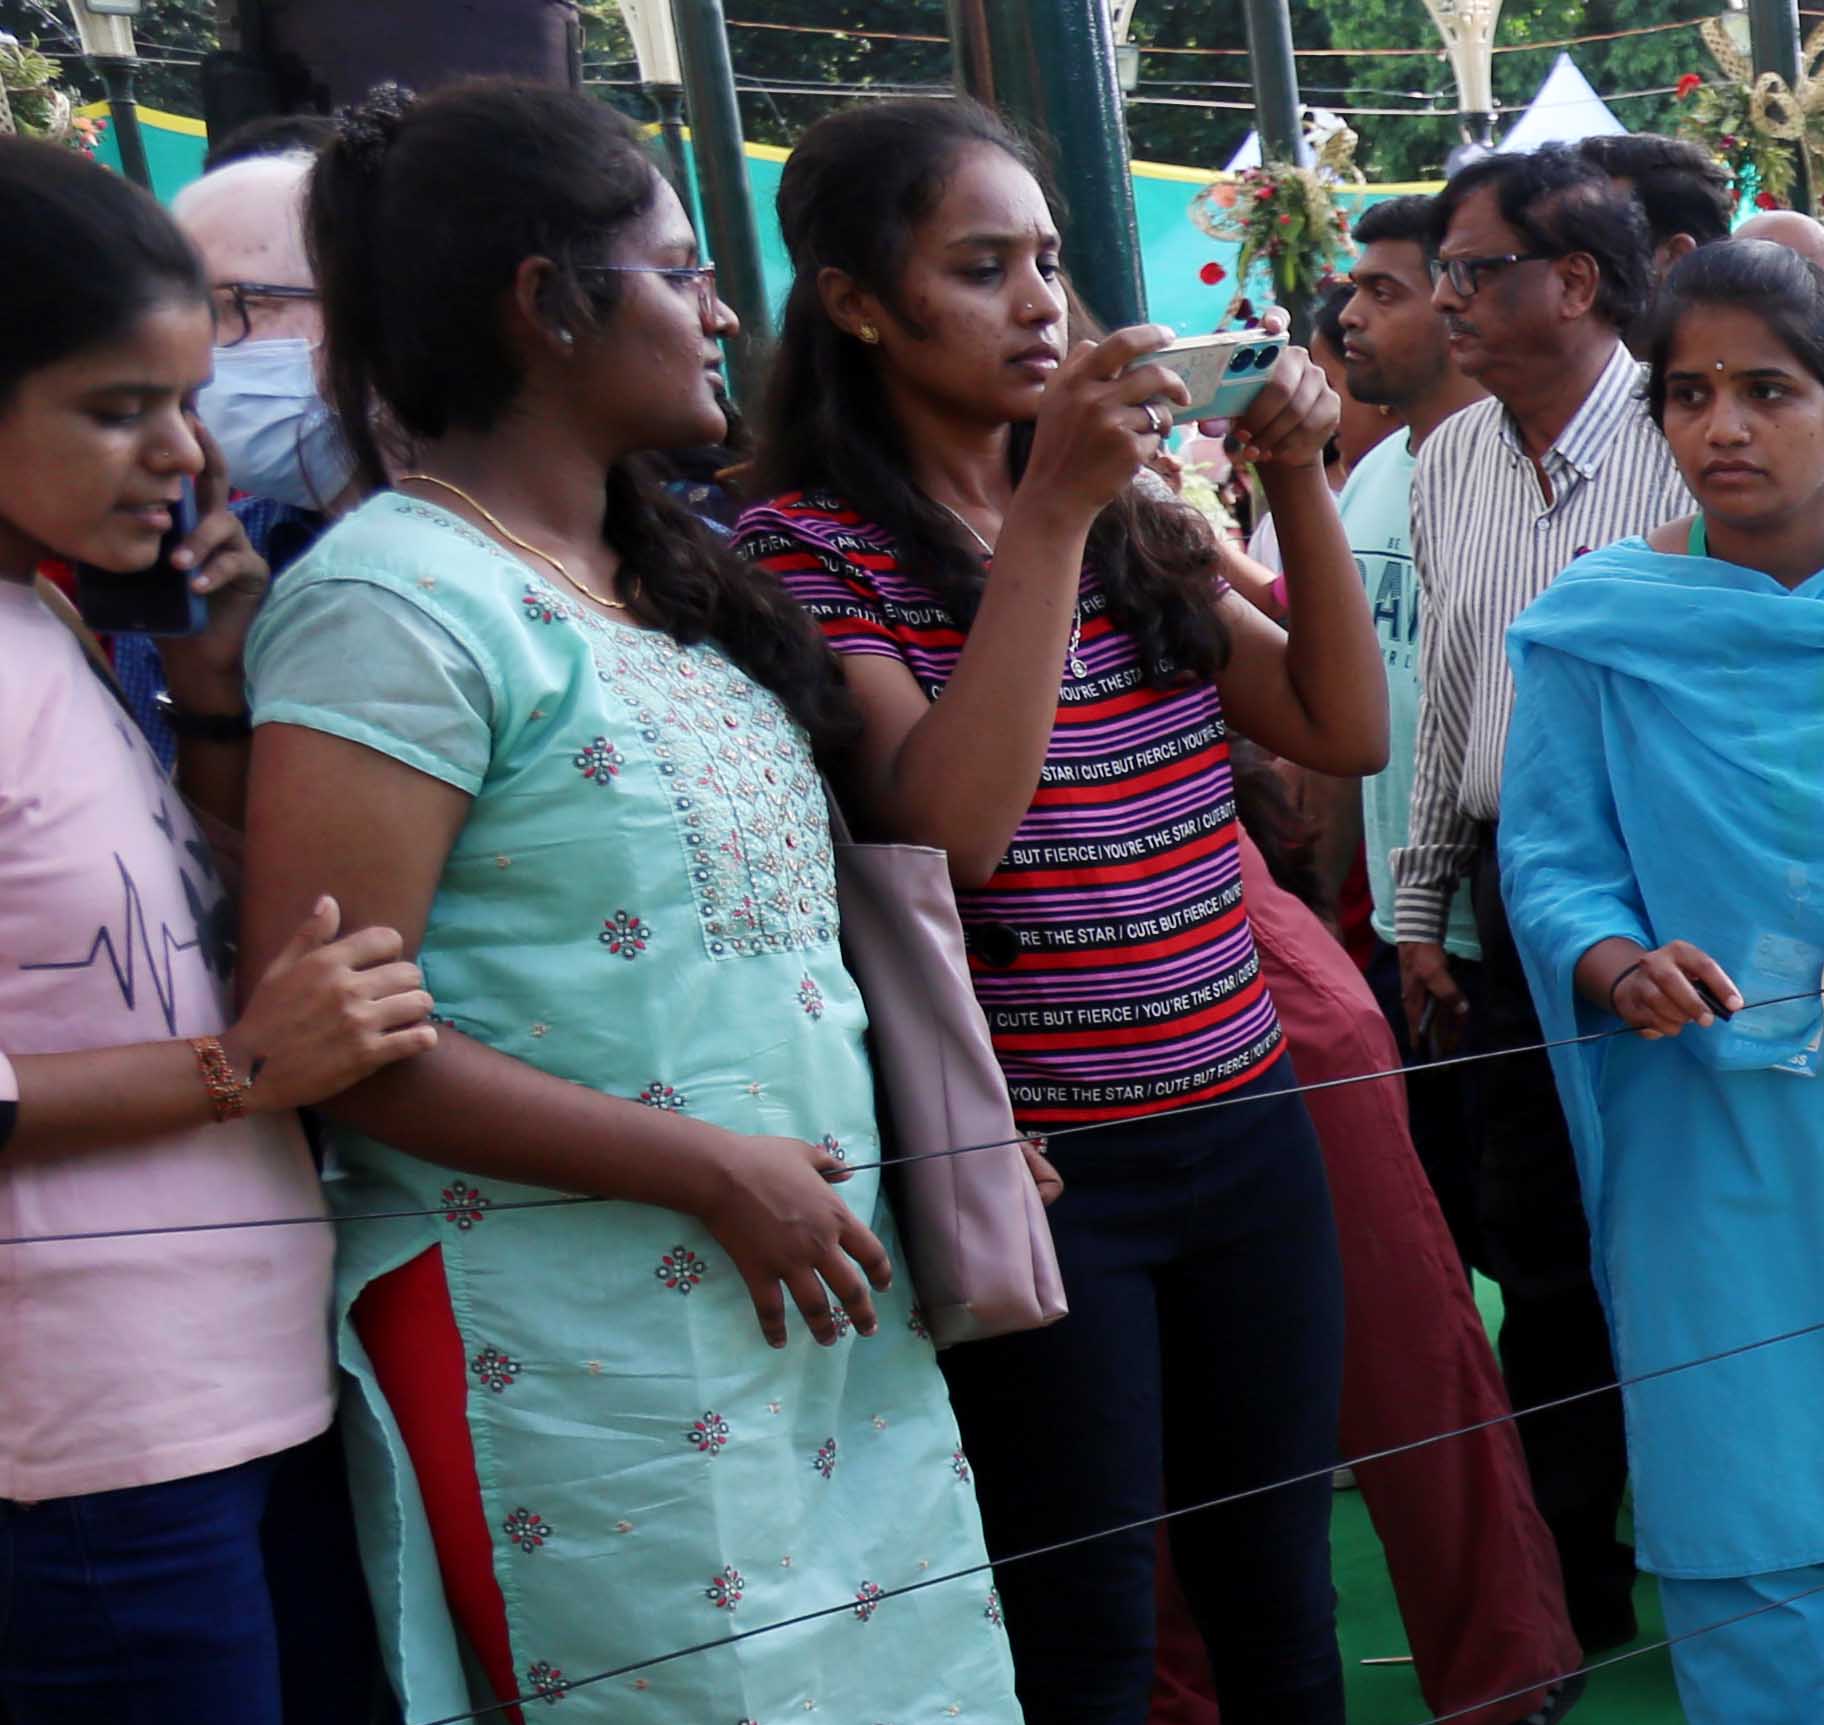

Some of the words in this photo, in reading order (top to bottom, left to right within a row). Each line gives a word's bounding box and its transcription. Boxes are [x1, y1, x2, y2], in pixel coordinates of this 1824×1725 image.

[1041, 764, 1073, 782] STAR
[1081, 762, 1112, 781] CUTE
[1112, 756, 1136, 775] BUT
[1136, 741, 1178, 769] FIERCE
[1013, 848, 1041, 865] BUT
[1045, 845, 1098, 864] FIERCE
[1103, 839, 1145, 860] YOU'RE
[1147, 830, 1172, 849] THE
[1171, 819, 1198, 842] STAR
[1078, 924, 1116, 944] STAR
[1127, 919, 1159, 940] CUTE
[1160, 911, 1183, 934] BUT
[1184, 897, 1219, 924] FIERCE
[996, 1011, 1039, 1027] CUTE
[1043, 1009, 1074, 1026] BUT
[1077, 1006, 1133, 1024] FIERCE
[1142, 994, 1191, 1018] YOU'RE
[1192, 984, 1212, 1006] THE
[1211, 974, 1237, 999] STAR
[1009, 1085, 1067, 1102] YOU'RE
[1071, 1086, 1101, 1102] THE
[1104, 1085, 1145, 1100] STAR
[1155, 1075, 1191, 1096] CUTE
[1192, 1067, 1218, 1086] BUT
[1216, 1051, 1250, 1079] FIERCE
